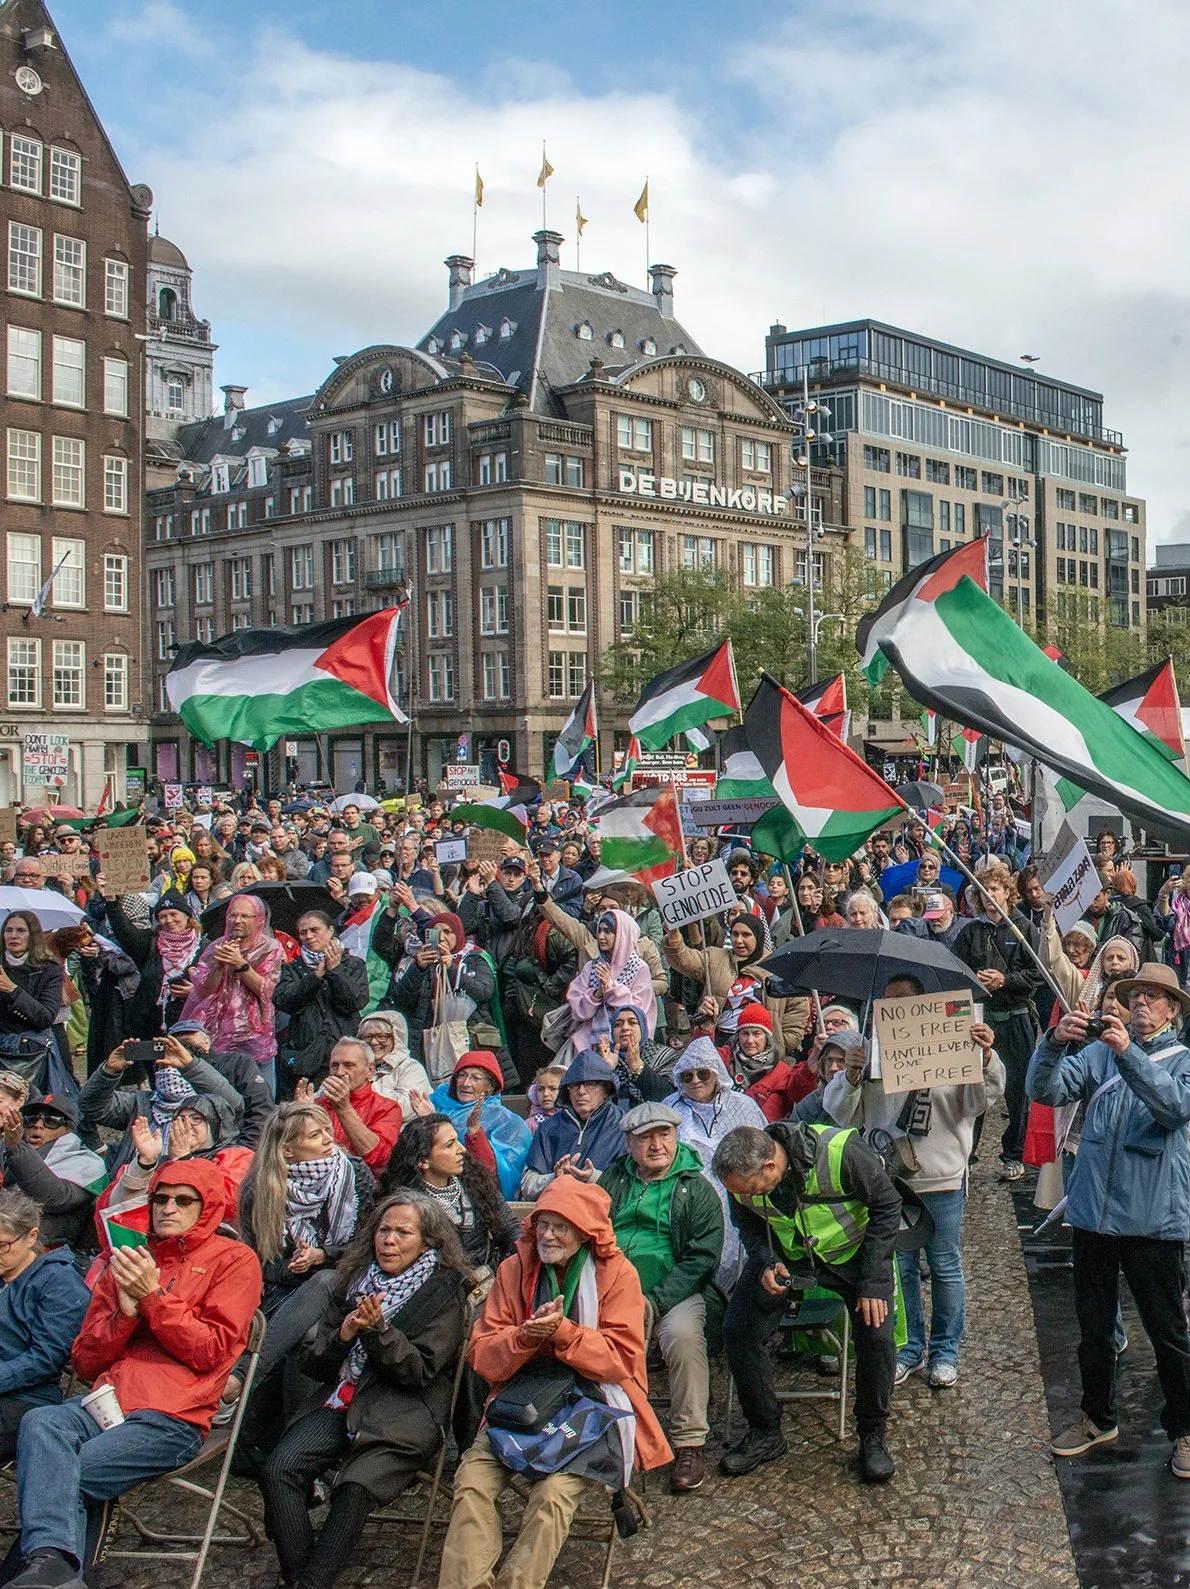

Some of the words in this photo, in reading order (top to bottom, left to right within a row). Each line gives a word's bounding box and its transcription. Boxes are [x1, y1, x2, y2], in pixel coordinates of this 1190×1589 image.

[619, 470, 656, 497] DE
[660, 477, 788, 515] BIJENKORF
[50, 735, 68, 746] LOOK
[31, 753, 62, 765] STOP
[24, 765, 38, 775] THE
[39, 766, 68, 775] GENOCIDE
[24, 775, 46, 784] TODAY
[704, 804, 721, 812] ZULT
[723, 803, 741, 811] GEEN
[743, 801, 780, 810] GENOCID
[105, 831, 126, 840] LAAT
[129, 829, 139, 838] DE
[104, 839, 142, 850] KINDEREN
[106, 856, 143, 872] LEVEN
[661, 864, 713, 897] STOP
[1054, 855, 1091, 910] amazon
[662, 882, 732, 924] GENOCIDE
[881, 1005, 905, 1022] NO
[911, 1001, 943, 1017] ONE
[892, 1026, 911, 1040] IS
[920, 1020, 966, 1037] FREE
[885, 1045, 936, 1062] UNTILL
[894, 1059, 923, 1070] ONE
[896, 1073, 914, 1087] IS
[922, 1065, 972, 1082] FREE
